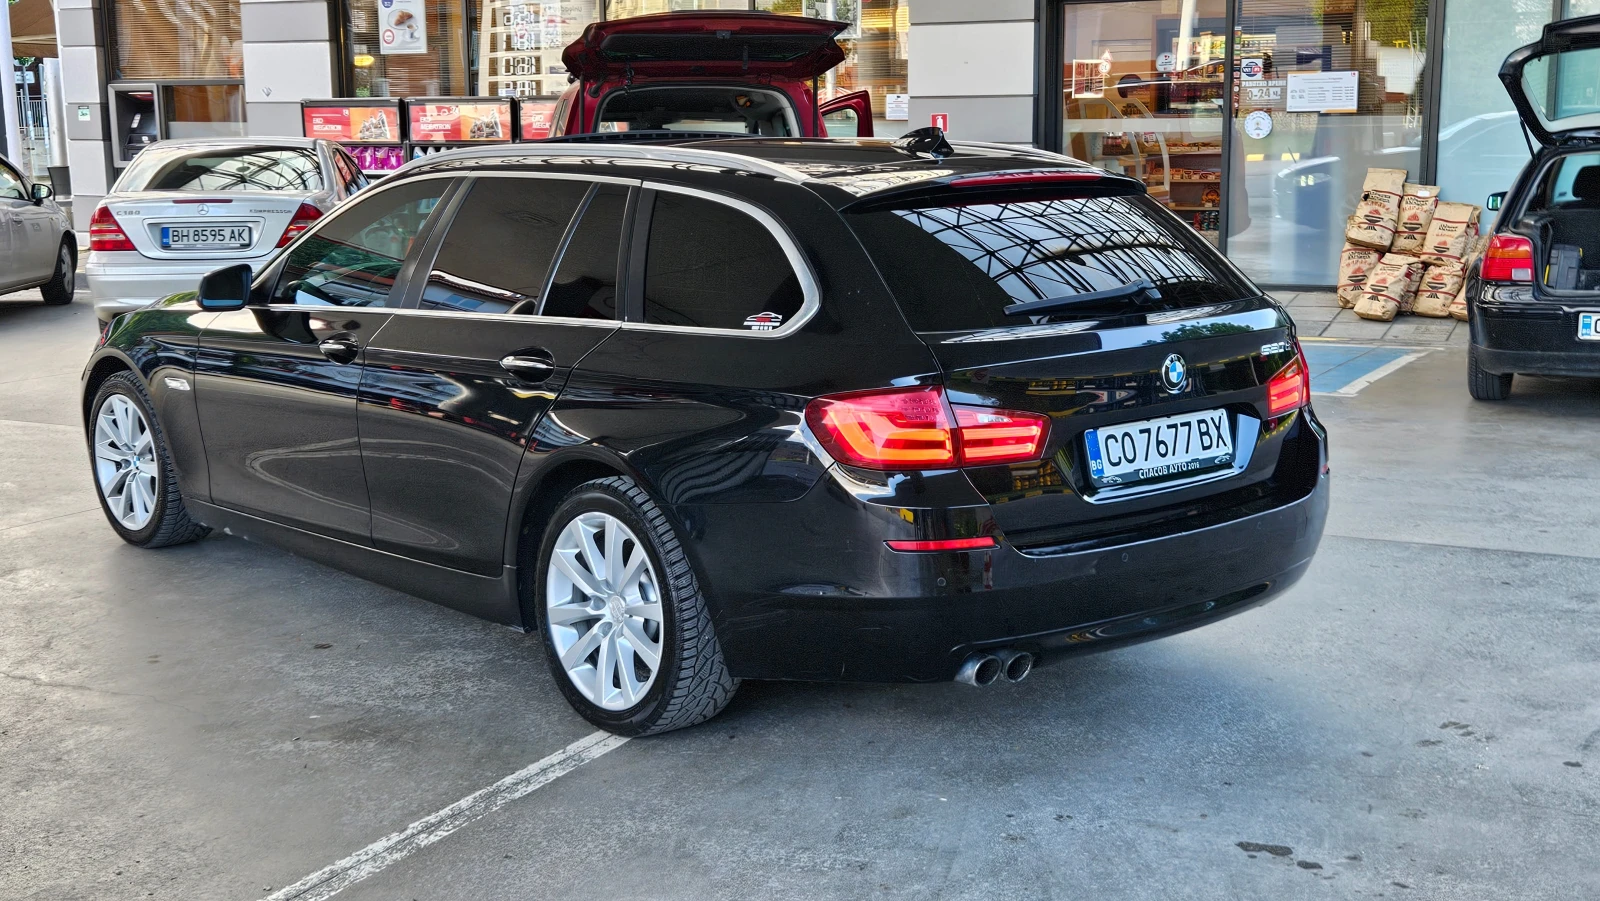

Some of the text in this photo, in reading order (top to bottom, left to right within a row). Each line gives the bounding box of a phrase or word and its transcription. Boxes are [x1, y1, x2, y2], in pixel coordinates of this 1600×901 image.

[171, 228, 246, 243] BH 8595 AK
[1104, 415, 1228, 467] CO 7677 BX
[1091, 459, 1103, 471] BG
[1138, 465, 1168, 479] СПАСОВ
[1169, 462, 1187, 474] АУТО
